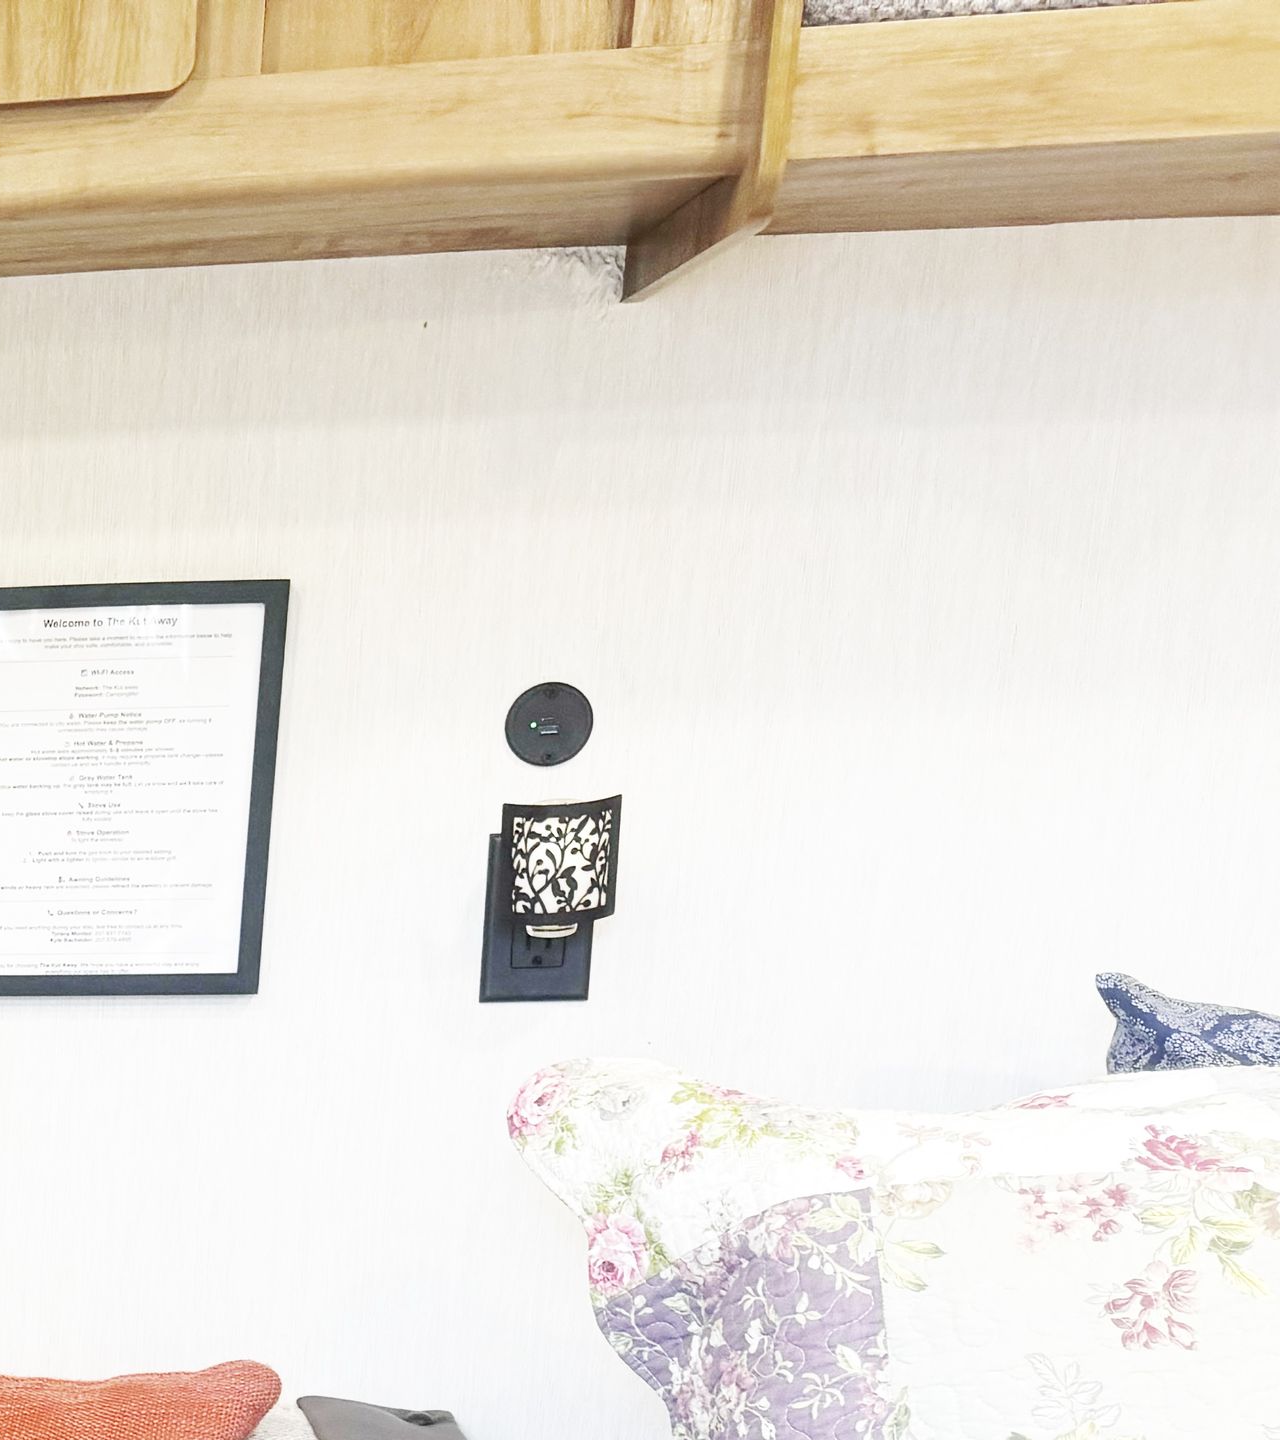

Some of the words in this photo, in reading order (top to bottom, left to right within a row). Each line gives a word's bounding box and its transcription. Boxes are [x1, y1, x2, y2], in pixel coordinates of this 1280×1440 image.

[43, 618, 90, 628] Welcome
[93, 618, 104, 628] to
[108, 617, 125, 627] The
[152, 617, 178, 628] way
[110, 668, 135, 676] Access
